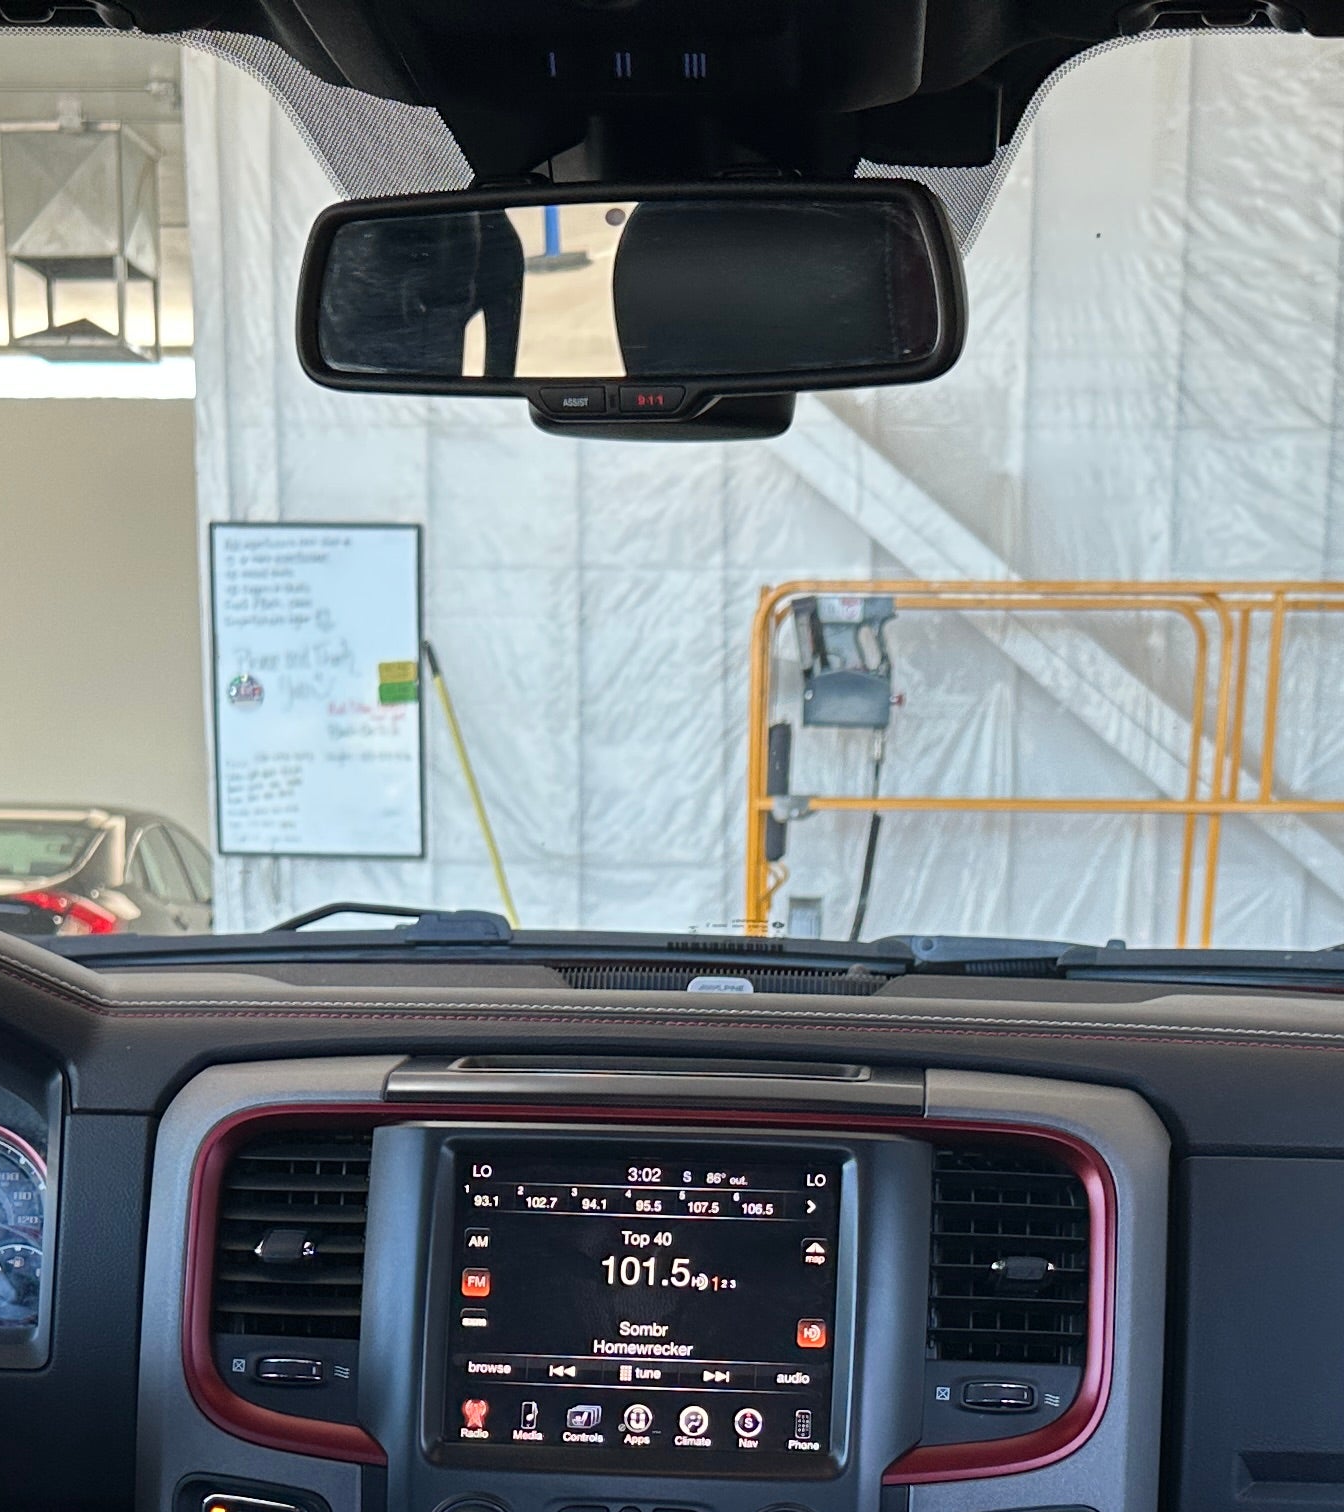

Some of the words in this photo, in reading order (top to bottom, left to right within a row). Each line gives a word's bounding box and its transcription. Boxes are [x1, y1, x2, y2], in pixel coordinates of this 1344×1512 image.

[562, 397, 589, 407] ASSIST
[637, 395, 665, 406] 911
[472, 1165, 493, 1178] LO
[627, 1167, 661, 1182] 3:02
[682, 1171, 692, 1183] S
[729, 1175, 748, 1186] out.
[806, 1174, 826, 1187] LO
[464, 1184, 470, 1193] 1
[517, 1186, 524, 1195] 2
[571, 1187, 578, 1197] 3
[625, 1190, 632, 1198] 4
[679, 1191, 686, 1200] 5
[733, 1192, 740, 1201] 6
[473, 1195, 499, 1207] 93.1
[525, 1197, 558, 1208] 102.7
[581, 1198, 607, 1210] 94.1
[635, 1200, 662, 1212] 95.5
[687, 1201, 720, 1214] 107.5
[742, 1203, 774, 1216] 106.5
[17, 1216, 39, 1224] 120
[468, 1236, 489, 1247] AM
[621, 1230, 650, 1248] Top
[653, 1231, 672, 1246] 40
[805, 1255, 826, 1265] map
[601, 1255, 690, 1287] 101.5
[712, 1276, 720, 1291] 1
[720, 1279, 728, 1289] 2
[729, 1279, 736, 1289] 3
[467, 1276, 486, 1288] FM
[619, 1321, 669, 1337] Sombr
[593, 1339, 694, 1356] Homewrecker
[468, 1361, 512, 1374] browse
[635, 1365, 661, 1379] tune
[776, 1371, 810, 1385] audio
[460, 1427, 489, 1439] Radio
[512, 1430, 543, 1441] Media
[562, 1432, 603, 1443] Controls
[624, 1434, 651, 1446] Apps
[674, 1435, 712, 1447] Climate
[738, 1437, 758, 1448] Nav
[788, 1439, 820, 1451] Phone
